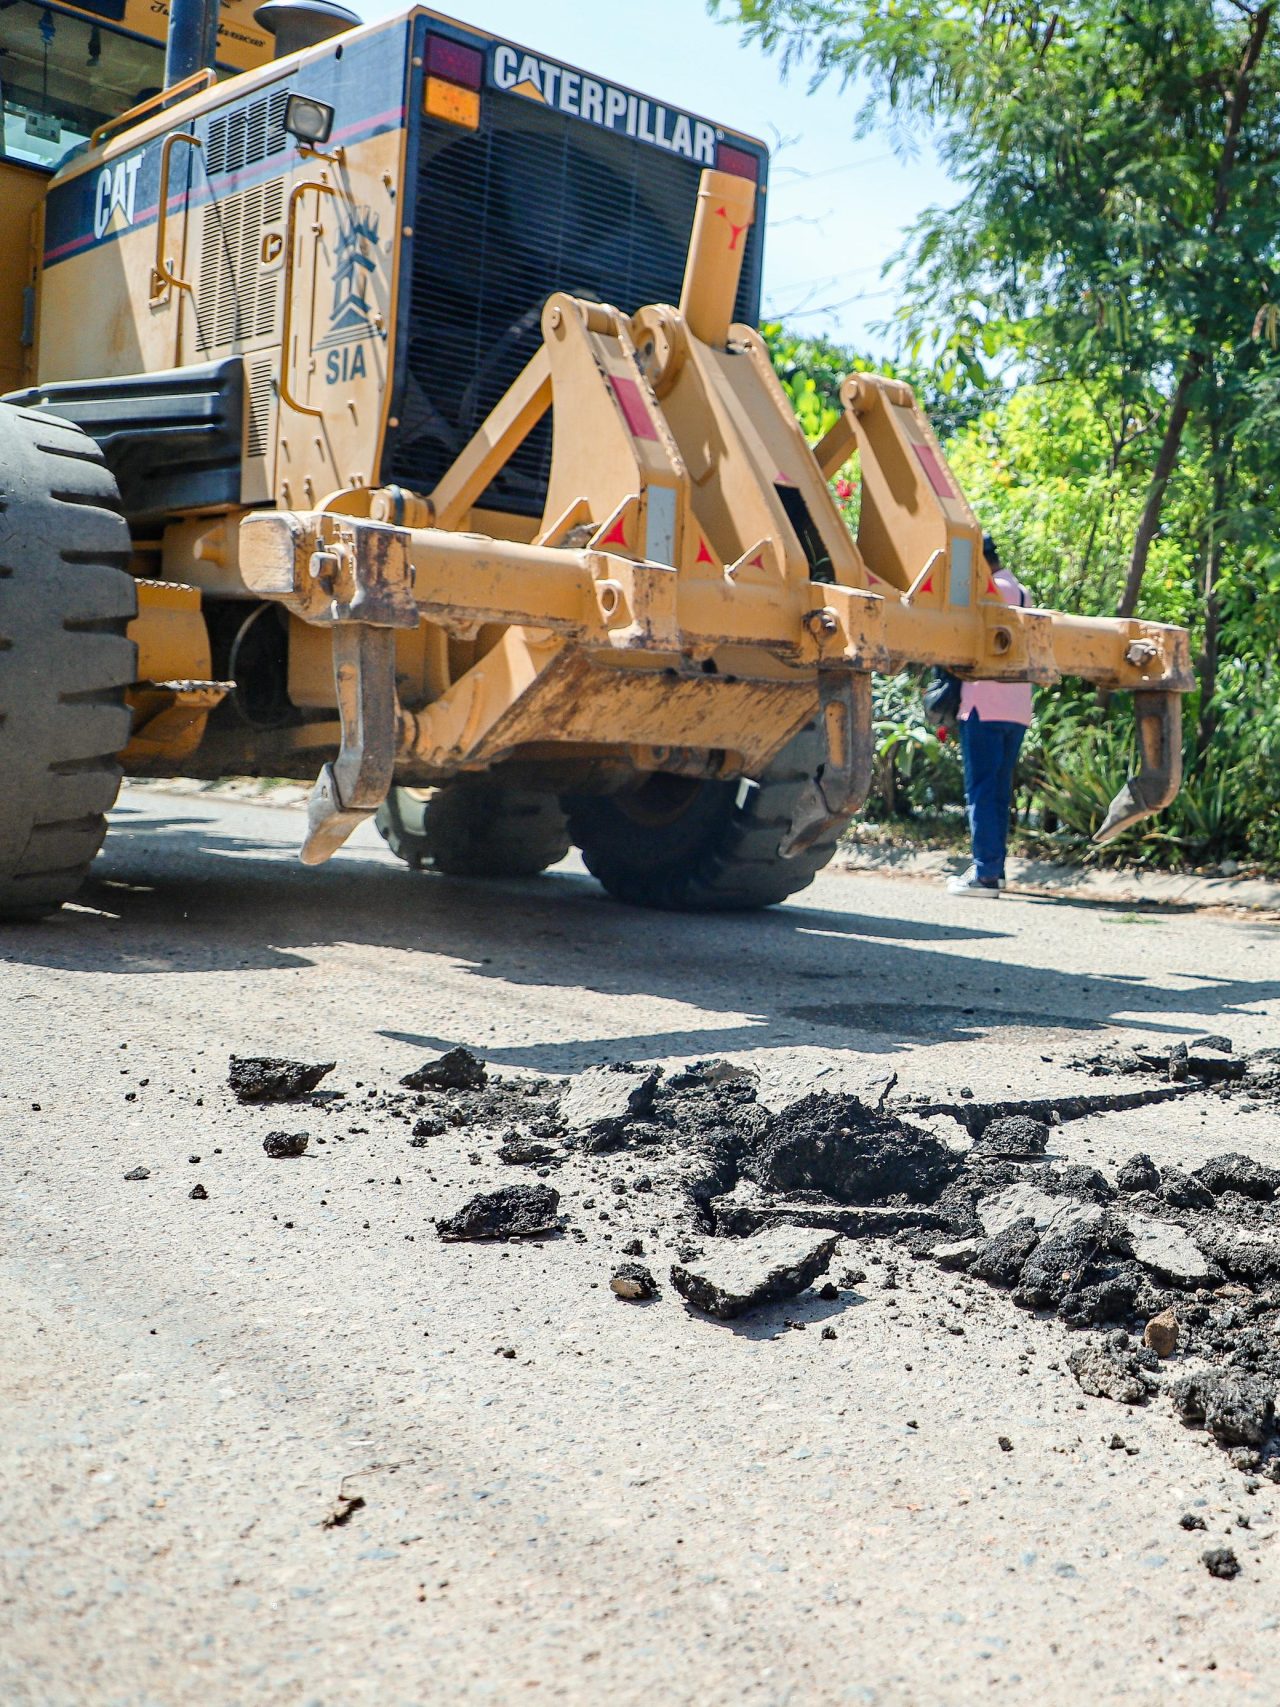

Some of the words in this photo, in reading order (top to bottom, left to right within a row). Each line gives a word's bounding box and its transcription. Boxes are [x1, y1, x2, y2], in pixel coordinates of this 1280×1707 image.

[493, 45, 716, 166] CATERPILLAR
[94, 153, 143, 239] CAT
[326, 344, 367, 385] SIA
